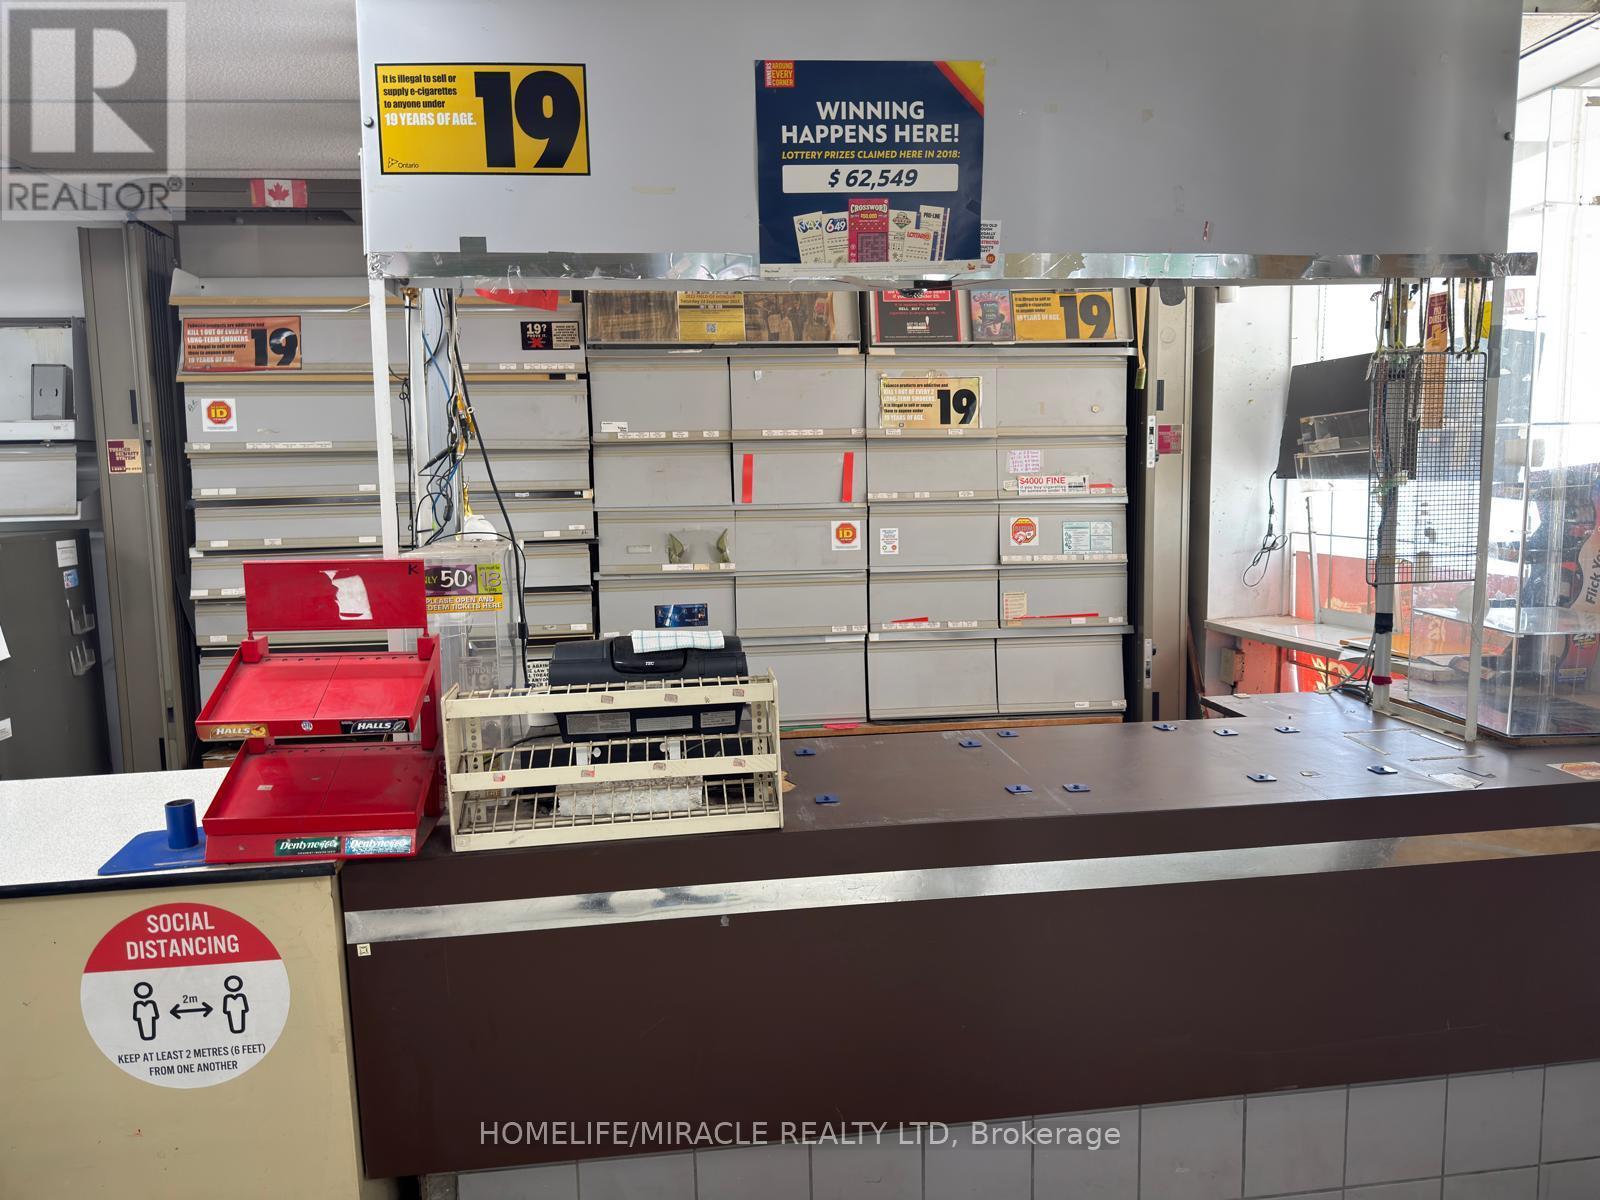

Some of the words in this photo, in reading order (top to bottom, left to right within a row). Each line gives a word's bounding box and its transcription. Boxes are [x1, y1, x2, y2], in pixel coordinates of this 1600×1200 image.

[382, 75, 388, 83] It
[389, 75, 396, 83] is
[397, 74, 422, 84] illegal
[423, 75, 430, 83] to
[432, 74, 446, 83] sell
[448, 75, 456, 83] or
[772, 70, 793, 79] EVERY
[383, 87, 408, 97] supply
[410, 87, 457, 96] e-cigarettes
[384, 101, 392, 109] to
[393, 101, 421, 109] anyone
[422, 100, 446, 109] under
[816, 101, 925, 120] WINNING
[384, 114, 398, 126] 19
[399, 113, 434, 126] YEARS
[437, 113, 450, 125] OF
[452, 113, 477, 126] AGE.
[474, 70, 581, 168] 19
[781, 125, 887, 144] HAPPENS
[895, 124, 959, 143] HERE!
[781, 151, 823, 160] LOTTERY
[824, 151, 855, 159] PRIZES
[857, 150, 897, 159] CLAIMED
[899, 150, 922, 159] HERE
[924, 150, 934, 158] IN
[937, 150, 960, 159] 2018:
[828, 169, 841, 188] $
[845, 169, 918, 190] 62,549
[850, 204, 888, 213] CROSSWORD
[1059, 294, 1111, 339] 19
[1434, 306, 1443, 315] PAY
[1428, 313, 1447, 325] DIRECT
[527, 323, 547, 334] 19?
[251, 327, 298, 366] 19
[211, 406, 228, 418] ID
[937, 388, 977, 424] 19
[1020, 477, 1043, 485] $4000
[1046, 476, 1066, 484] FINE
[839, 528, 853, 538] ID
[480, 571, 501, 587] 18
[1585, 573, 1600, 604] Flick
[426, 597, 454, 605] PLEASE
[216, 727, 250, 735] HALLS
[357, 722, 392, 730] HALLS
[280, 838, 321, 850] Dentyne
[350, 838, 385, 850] Dentyne
[147, 911, 215, 934] SOCIAL
[126, 935, 240, 960] DISTANCING
[182, 995, 198, 1004] 2m
[118, 1053, 141, 1064] KEEP
[143, 1052, 154, 1062] AT
[156, 1050, 183, 1061] LEAST
[186, 1050, 192, 1059] 2
[194, 1047, 229, 1059] METRES
[231, 1045, 240, 1056] (6
[242, 1043, 266, 1055] FEET)
[149, 1065, 175, 1076] FROM
[177, 1064, 195, 1075] ONE
[197, 1061, 238, 1073] ANOTHER
